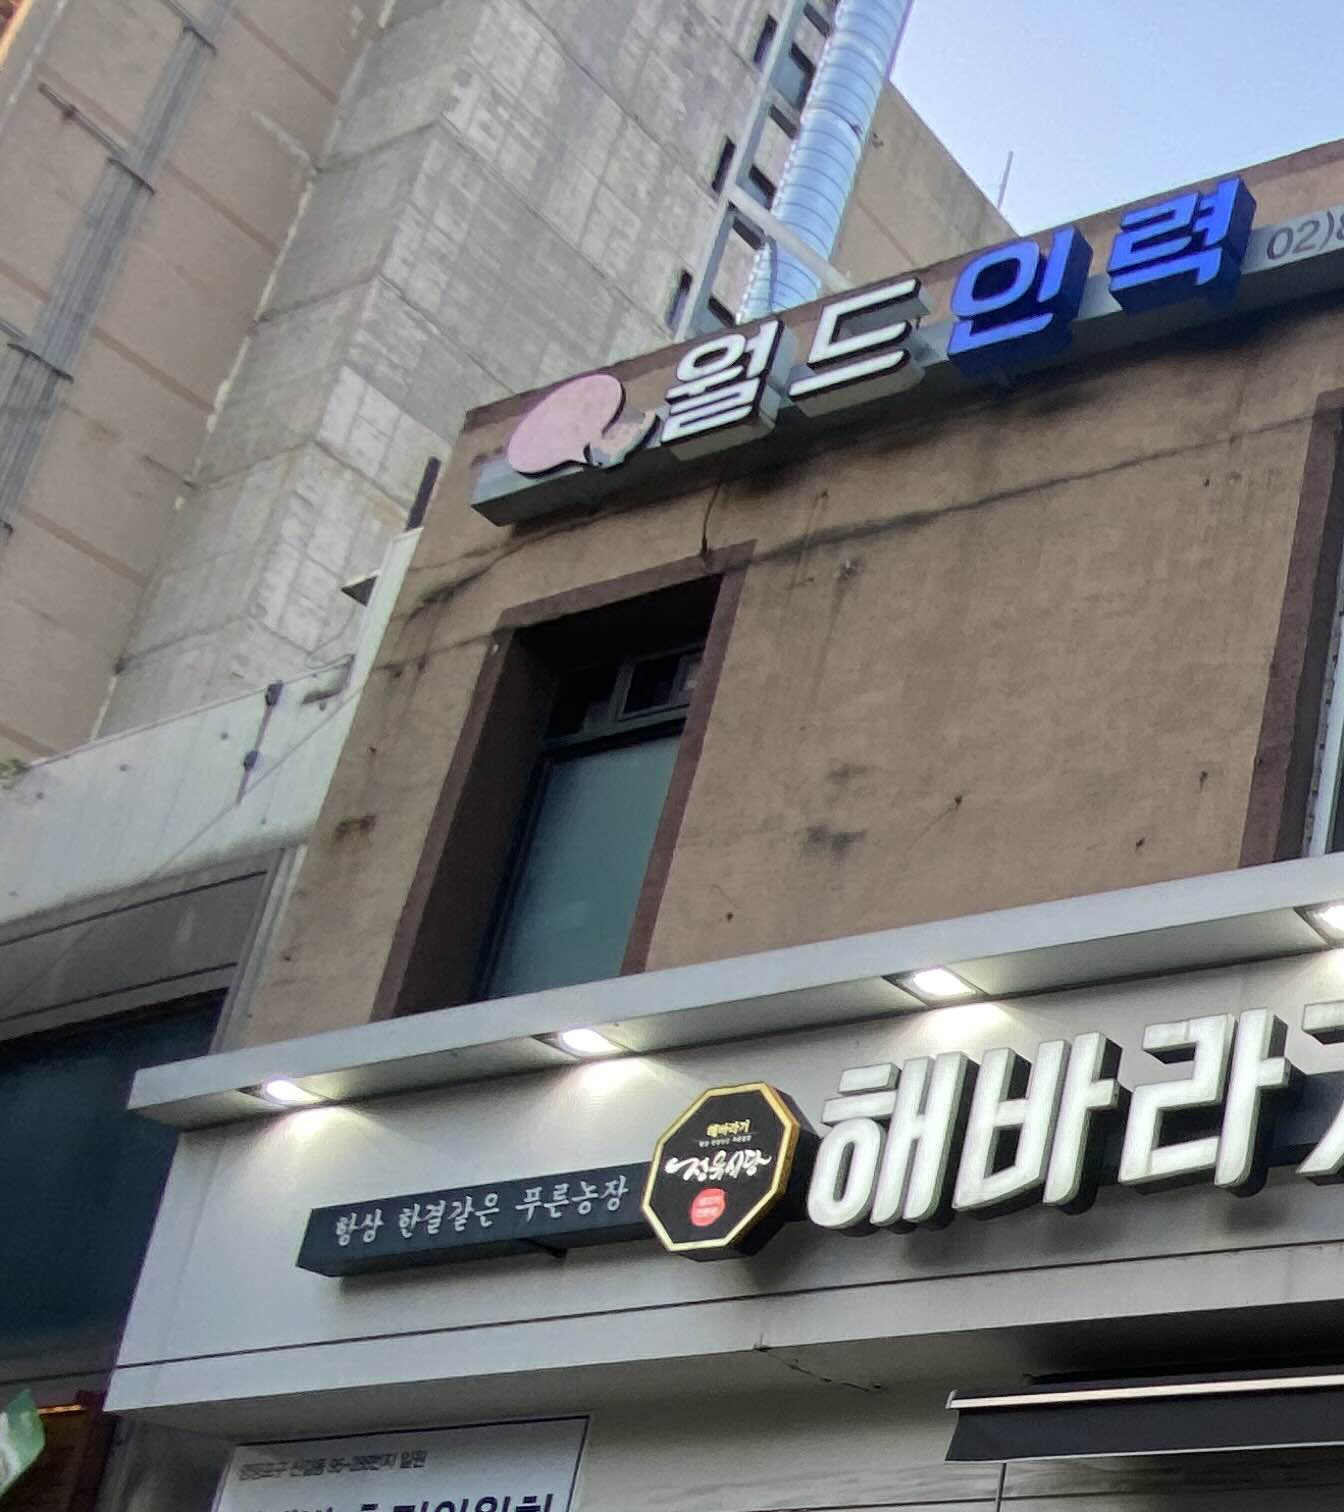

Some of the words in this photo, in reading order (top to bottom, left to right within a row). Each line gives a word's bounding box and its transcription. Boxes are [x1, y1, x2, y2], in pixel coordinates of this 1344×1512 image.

[660, 176, 1247, 449] 월드인력
[336, 1209, 383, 1246] 항상
[399, 1194, 499, 1238] 한결같은
[515, 1175, 628, 1222] 푸른농장
